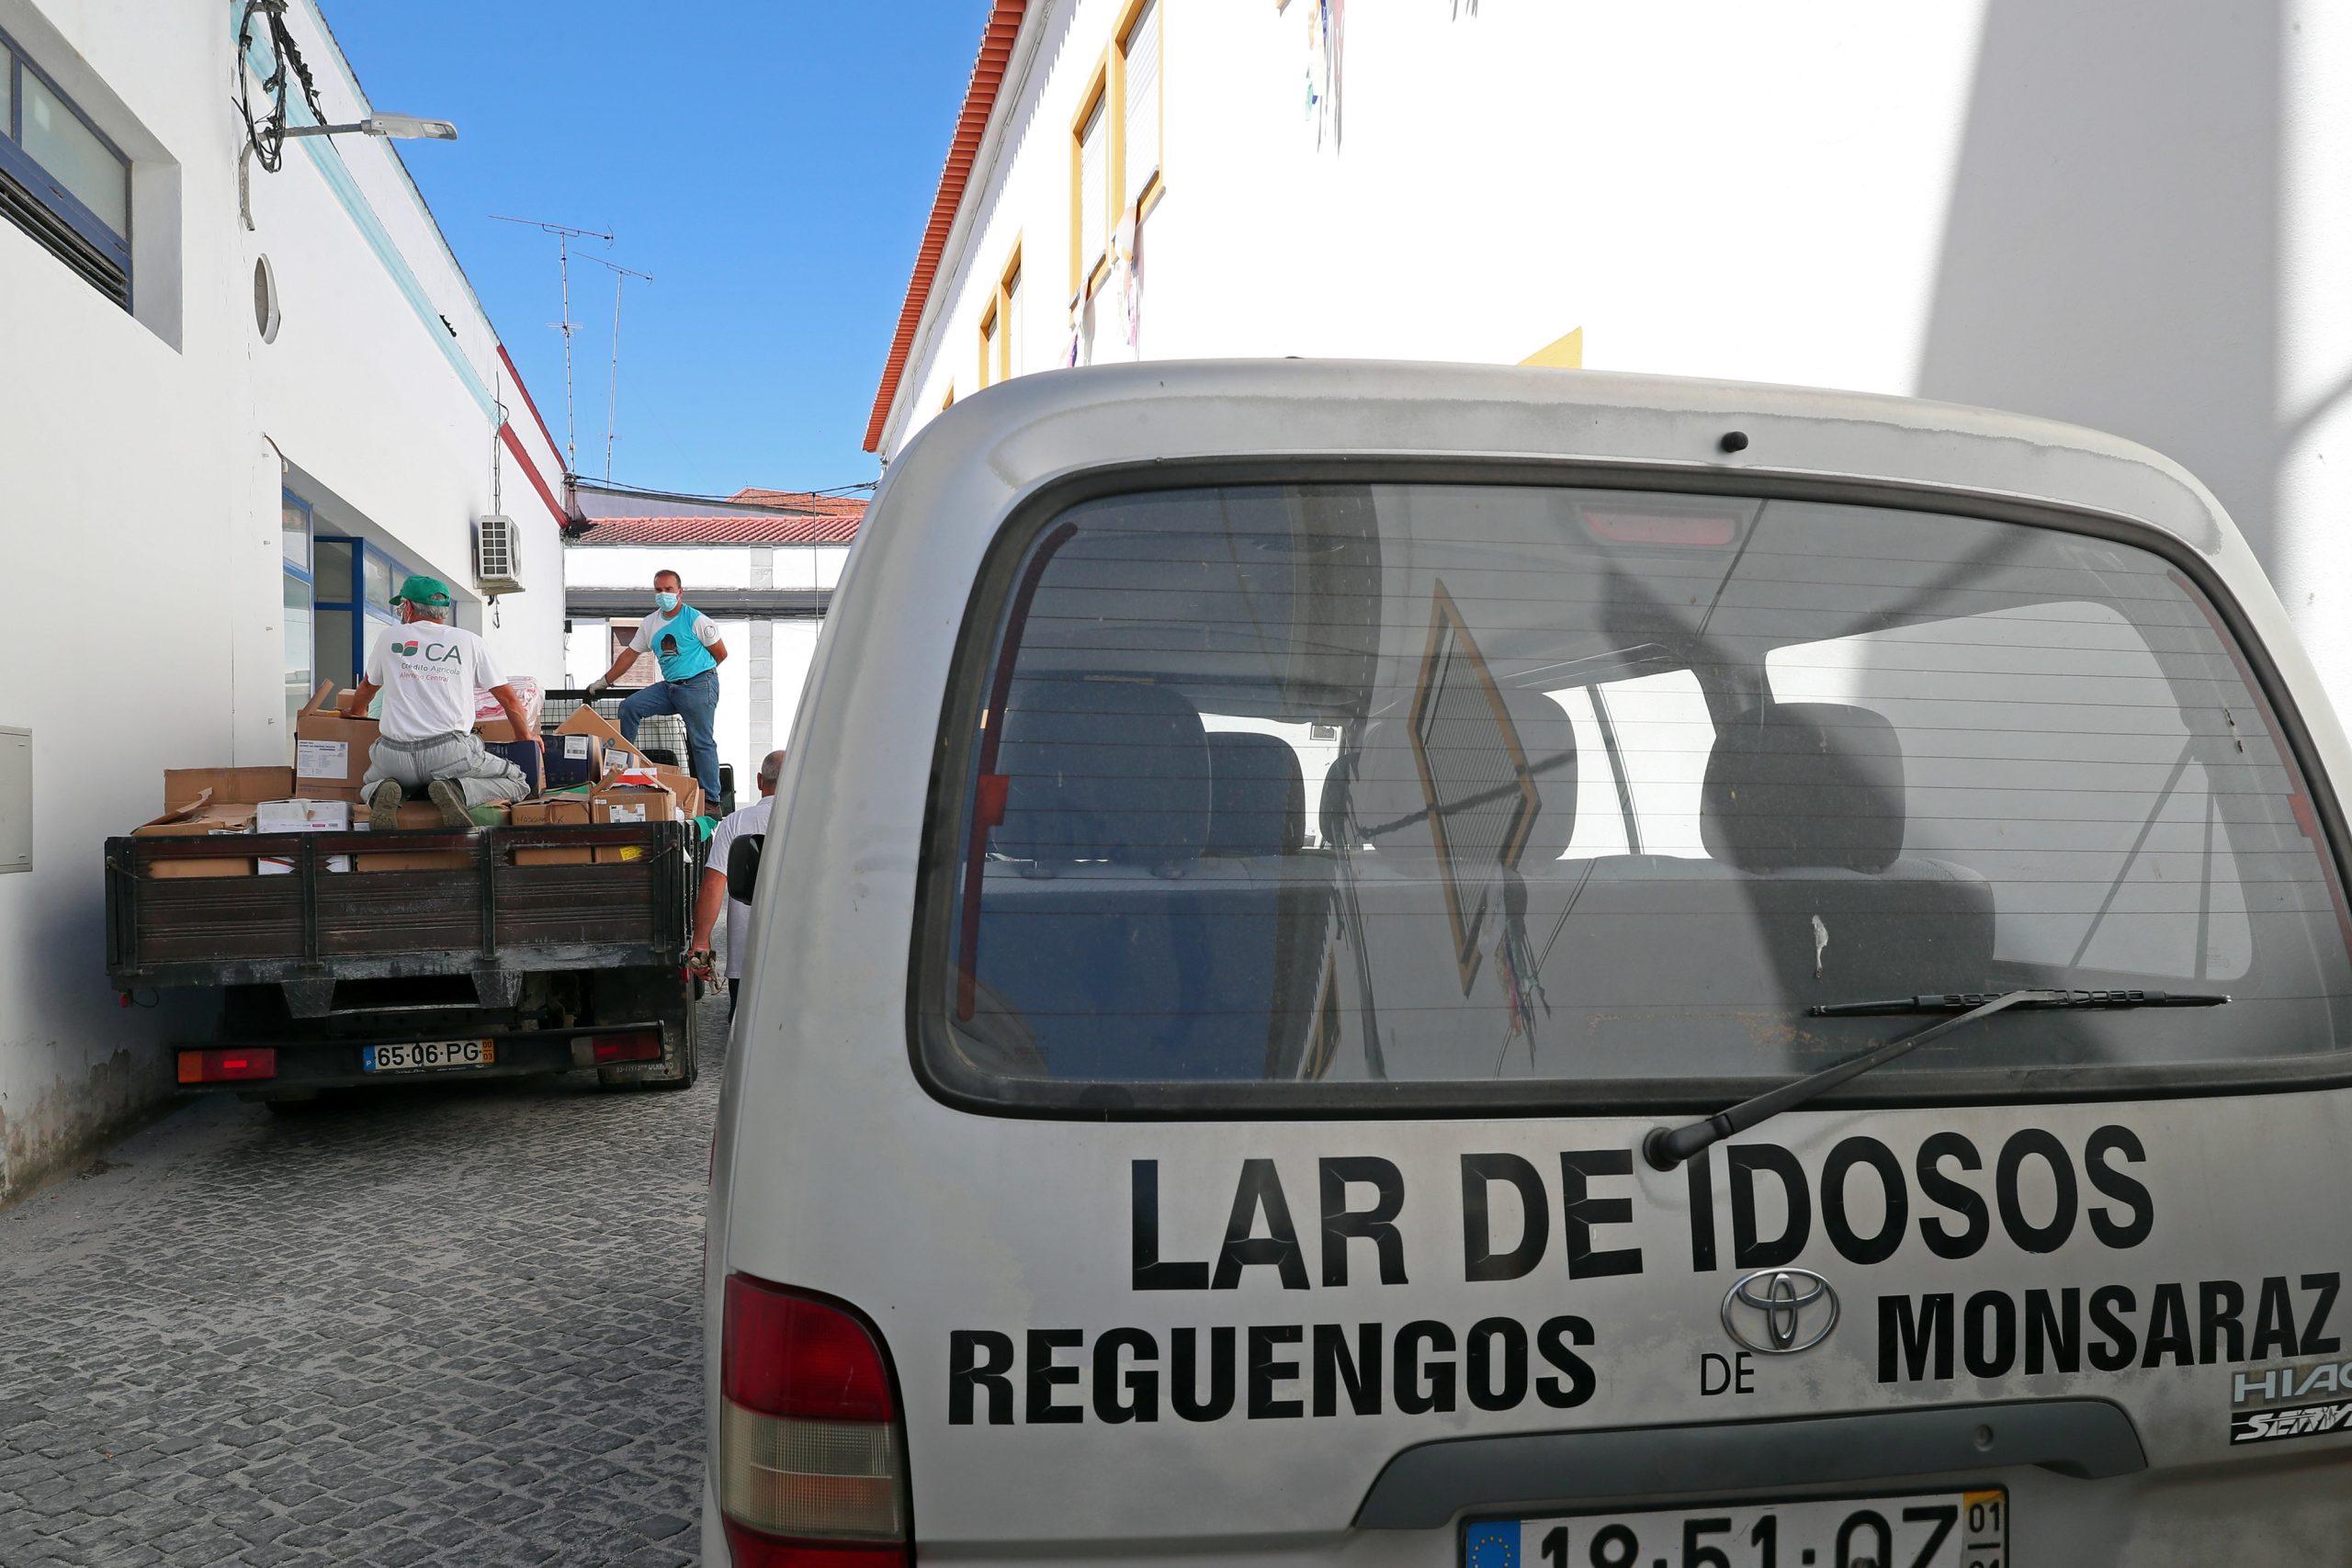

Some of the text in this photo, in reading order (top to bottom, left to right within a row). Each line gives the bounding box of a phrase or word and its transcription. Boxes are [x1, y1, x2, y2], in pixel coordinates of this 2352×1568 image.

[425, 643, 462, 665] CA
[1131, 1124, 2154, 1291] LAR DE IDOSOS
[948, 1271, 2341, 1426] REGUENGOS DE MONSARAZ
[1969, 1501, 2000, 1533] 01
